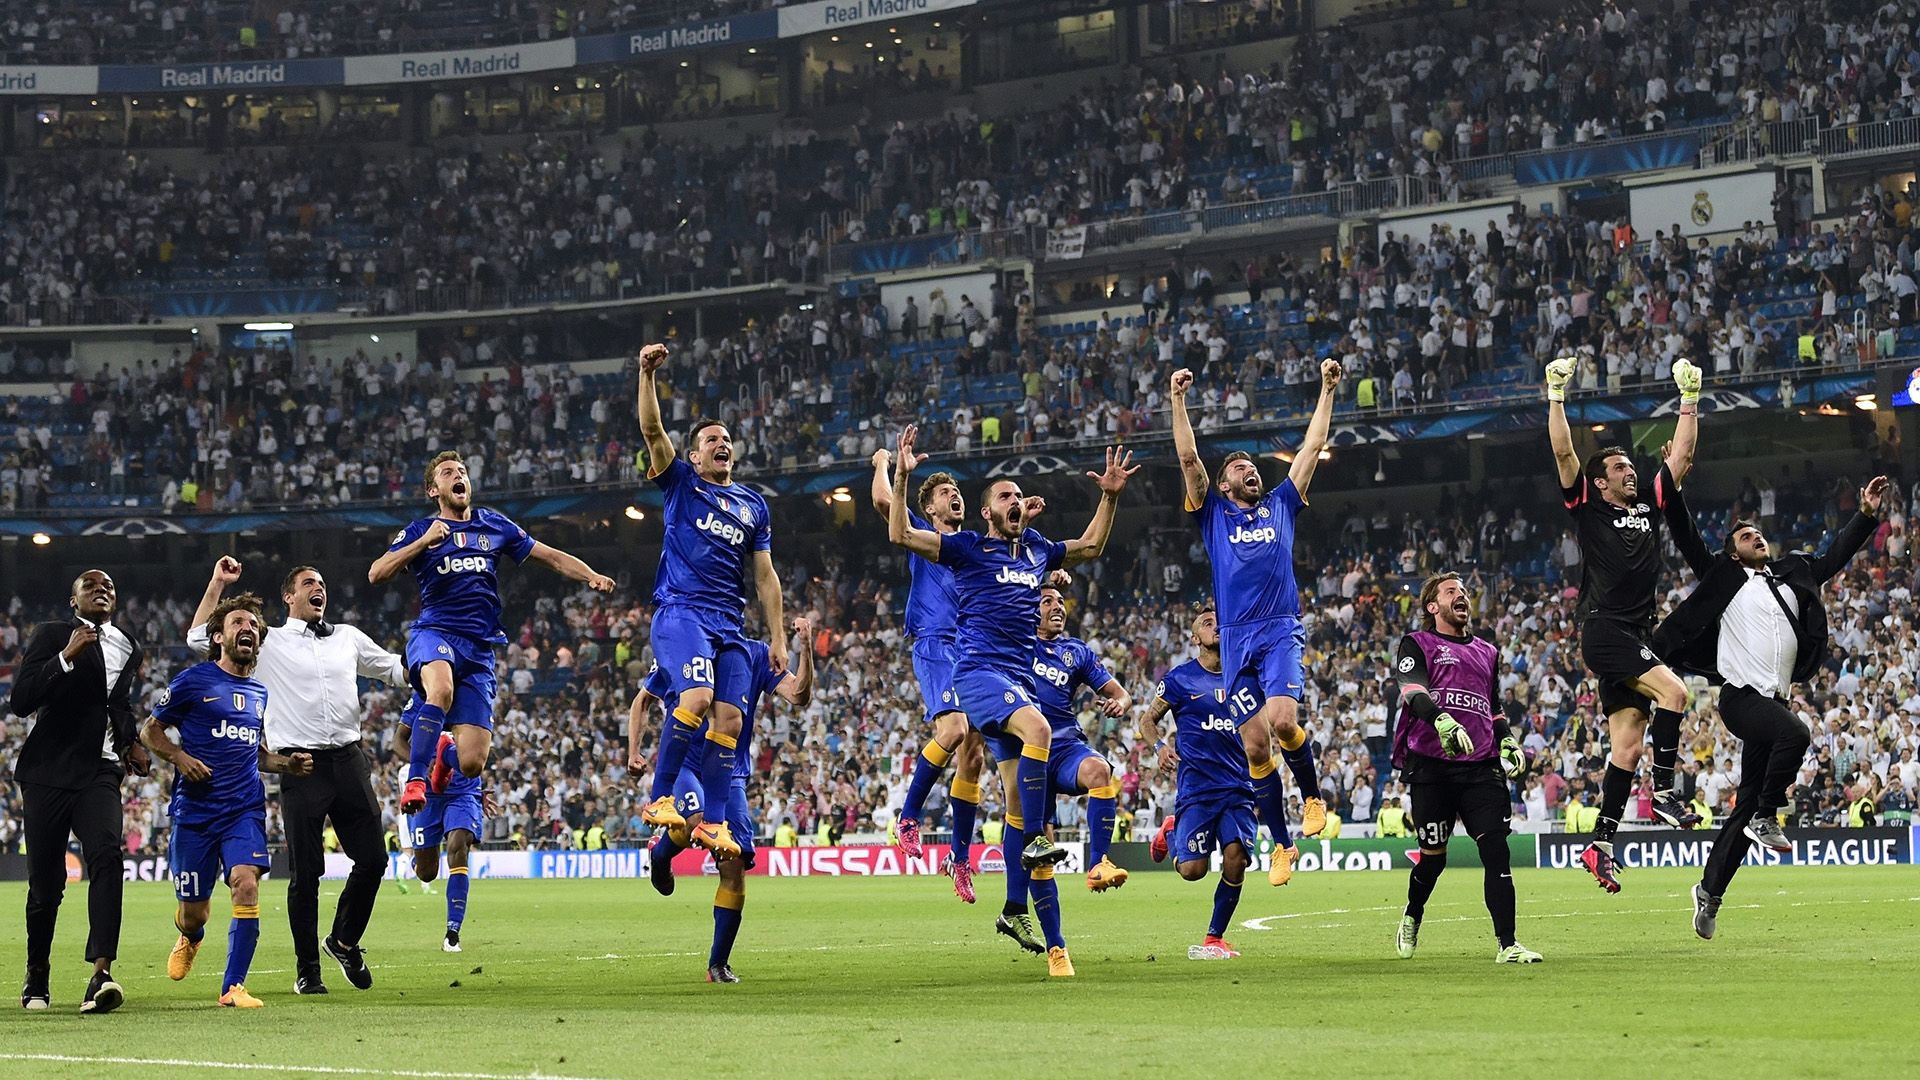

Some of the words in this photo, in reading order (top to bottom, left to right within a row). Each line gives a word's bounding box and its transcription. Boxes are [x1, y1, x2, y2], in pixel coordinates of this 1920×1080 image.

[825, 0, 862, 24] Real
[630, 31, 667, 54] Real
[671, 21, 730, 48] Madrid
[162, 68, 207, 87] Real
[212, 64, 285, 85] Madrid
[402, 59, 446, 78] Real
[453, 52, 520, 75] Madrid
[696, 512, 745, 546] Jeep
[1229, 526, 1276, 544] Jeep
[1613, 515, 1650, 533] Jeep
[437, 556, 488, 575] Jeep
[995, 565, 1039, 590] Jeep
[691, 656, 714, 682] 20
[1231, 687, 1257, 715] 15
[211, 719, 257, 745] Jeep
[1426, 820, 1448, 845] 30
[768, 849, 938, 877] NISSAN
[1623, 841, 1781, 868] CHAMPNS
[1792, 838, 1898, 866] LEAGUE
[180, 871, 199, 897] 21
